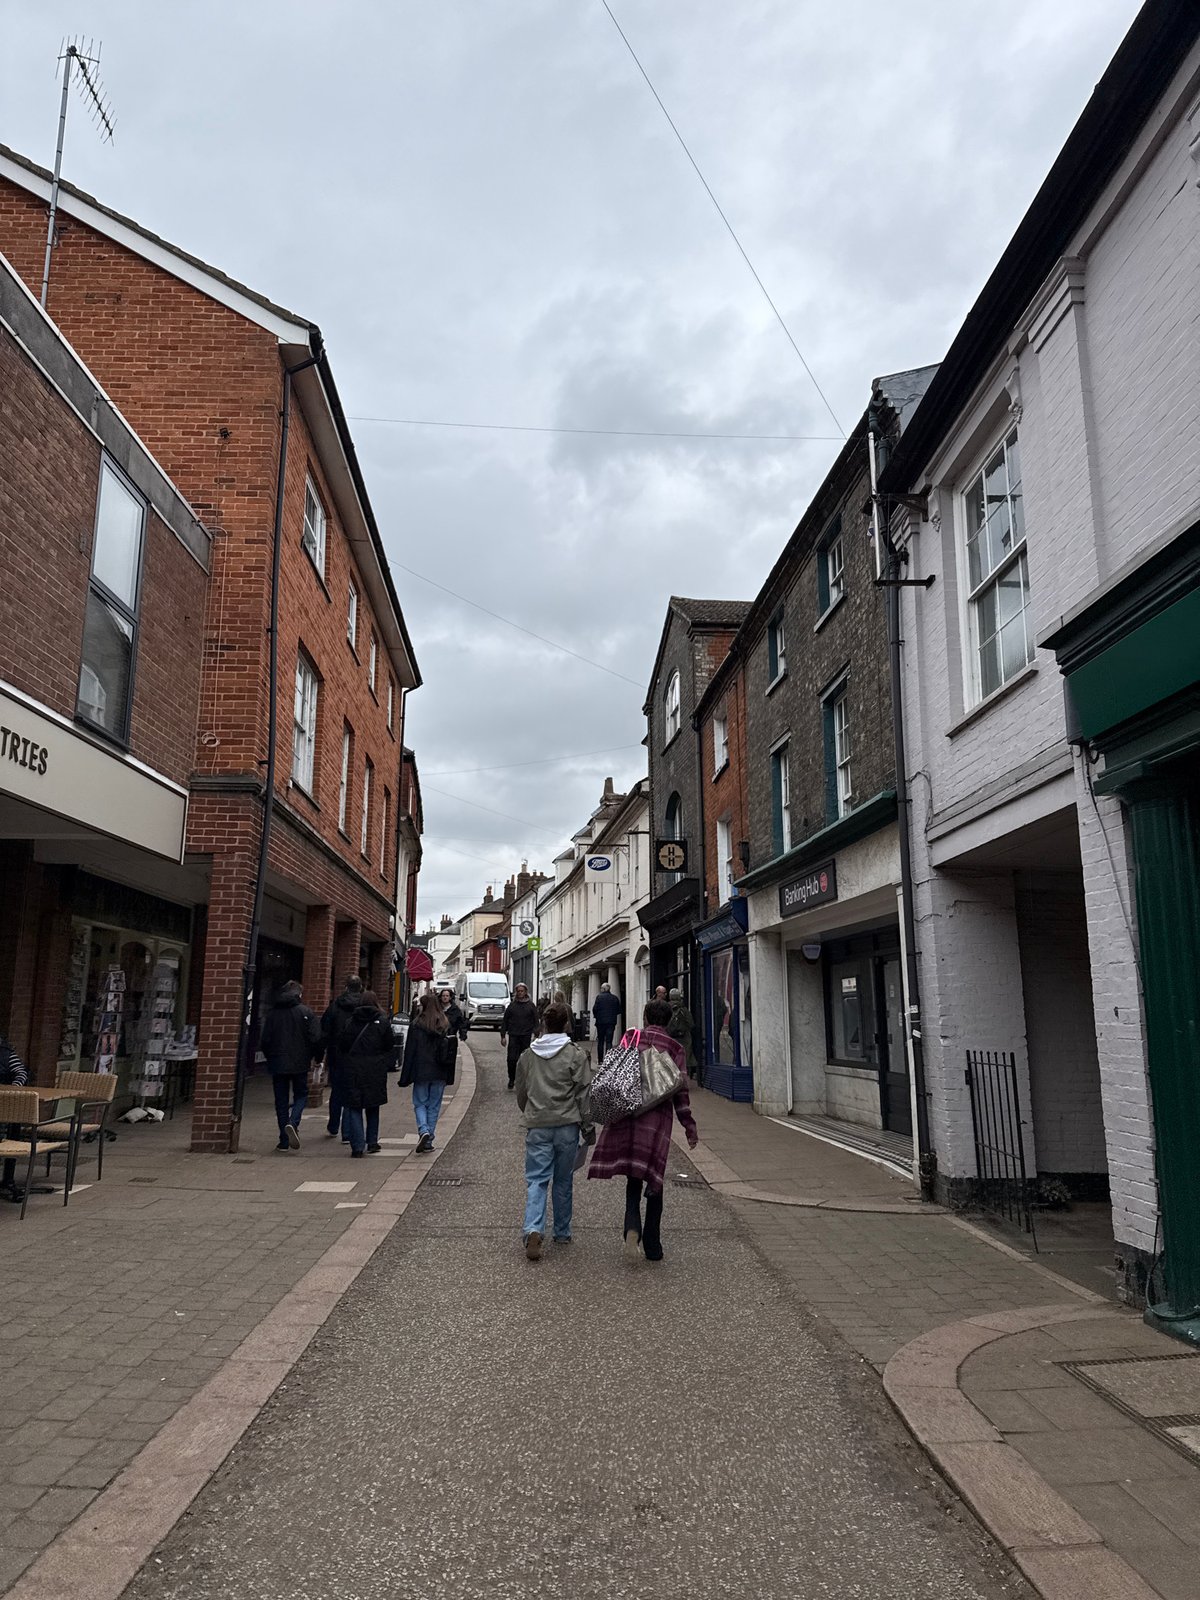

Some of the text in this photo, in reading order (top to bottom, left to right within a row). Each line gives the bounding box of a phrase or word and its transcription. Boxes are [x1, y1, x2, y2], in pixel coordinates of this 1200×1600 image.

[0, 726, 49, 775] TRIES
[667, 846, 675, 856] H
[667, 857, 676, 867] H
[784, 884, 806, 906] Banking
[805, 876, 819, 898] Hub
